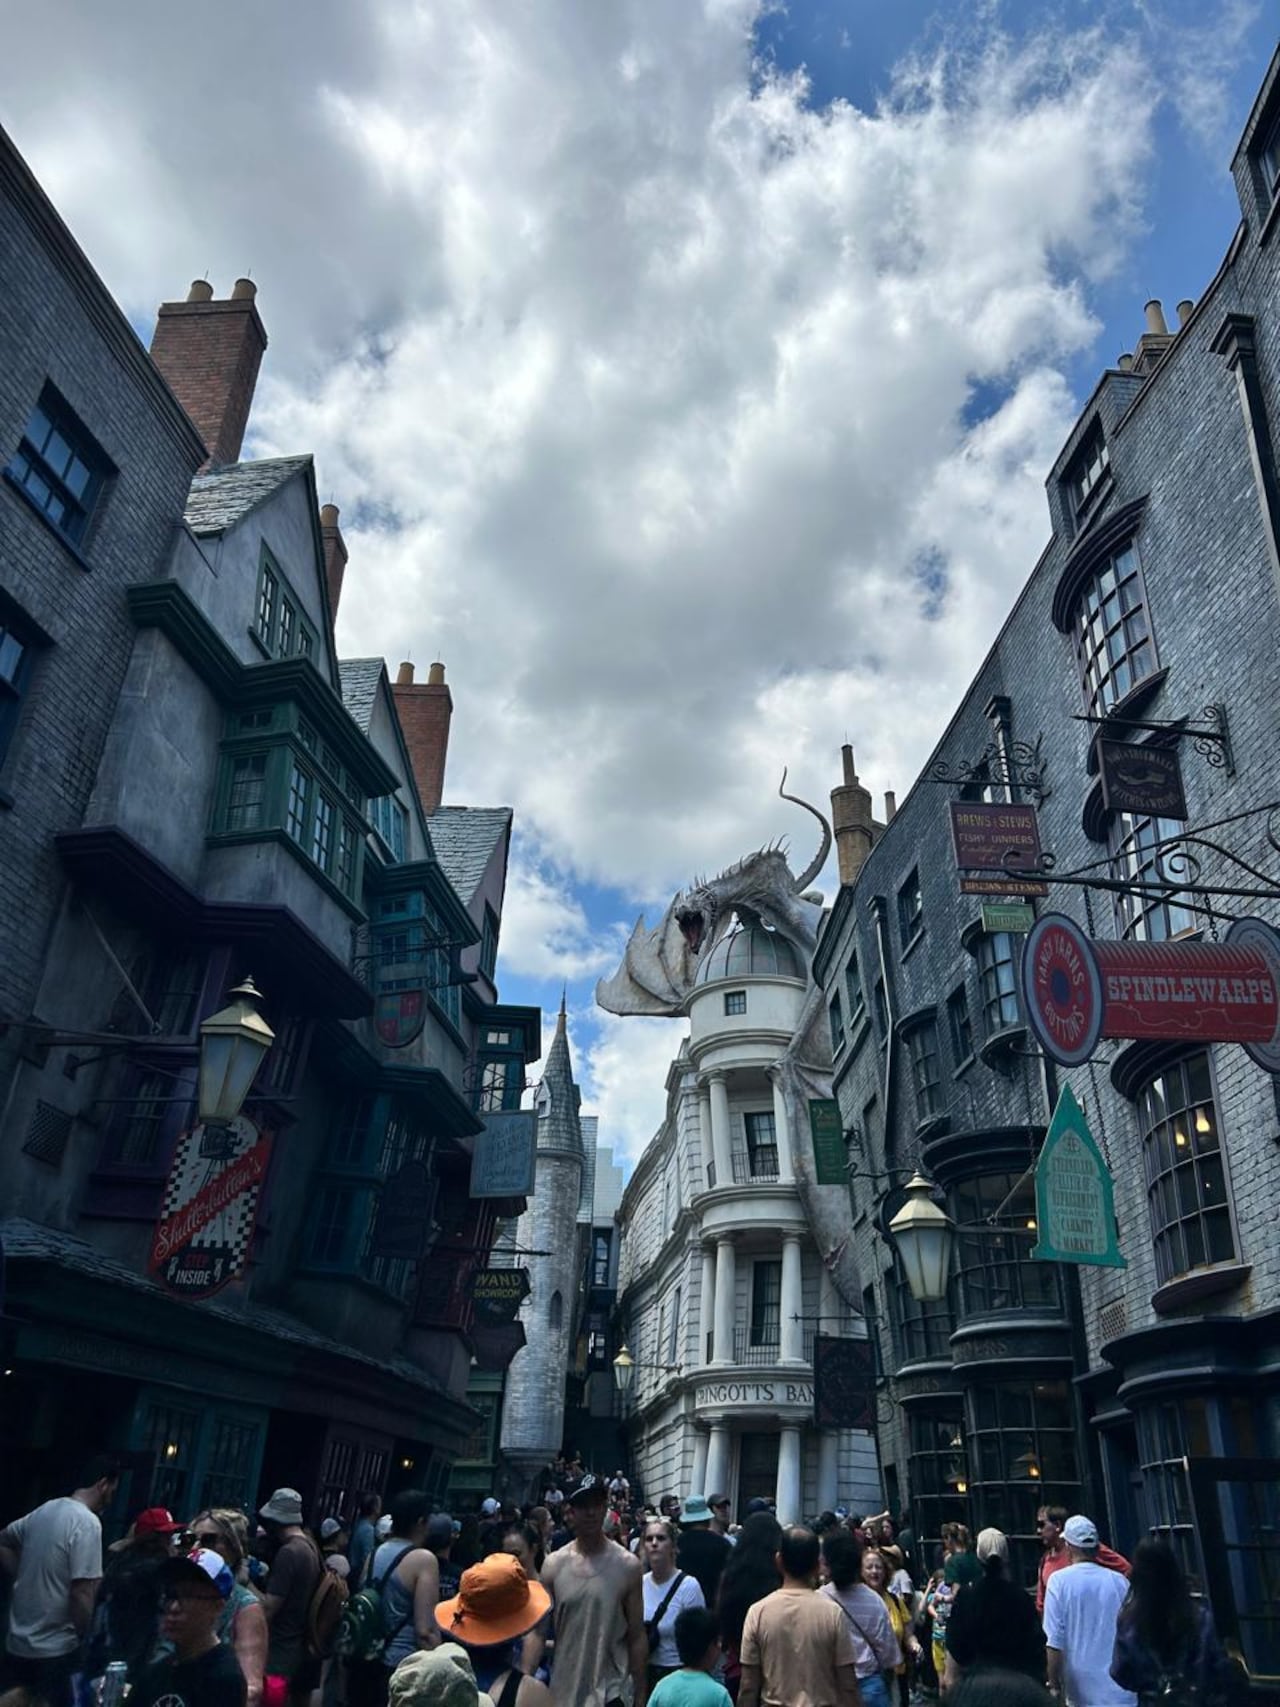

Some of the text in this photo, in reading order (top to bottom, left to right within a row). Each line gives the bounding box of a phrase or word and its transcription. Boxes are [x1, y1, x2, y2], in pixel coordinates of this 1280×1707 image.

[956, 813, 991, 827] BREWS
[998, 815, 1032, 829] STEWS
[1054, 935, 1085, 986] YARNS
[1107, 975, 1275, 1005] SPINDLEWARPS
[1044, 1001, 1085, 1042] BUTTONS
[184, 1253, 209, 1267] STEP
[175, 1269, 211, 1286] INSIDE
[475, 1273, 521, 1286] WAND
[474, 1287, 520, 1298] SHOWROOM
